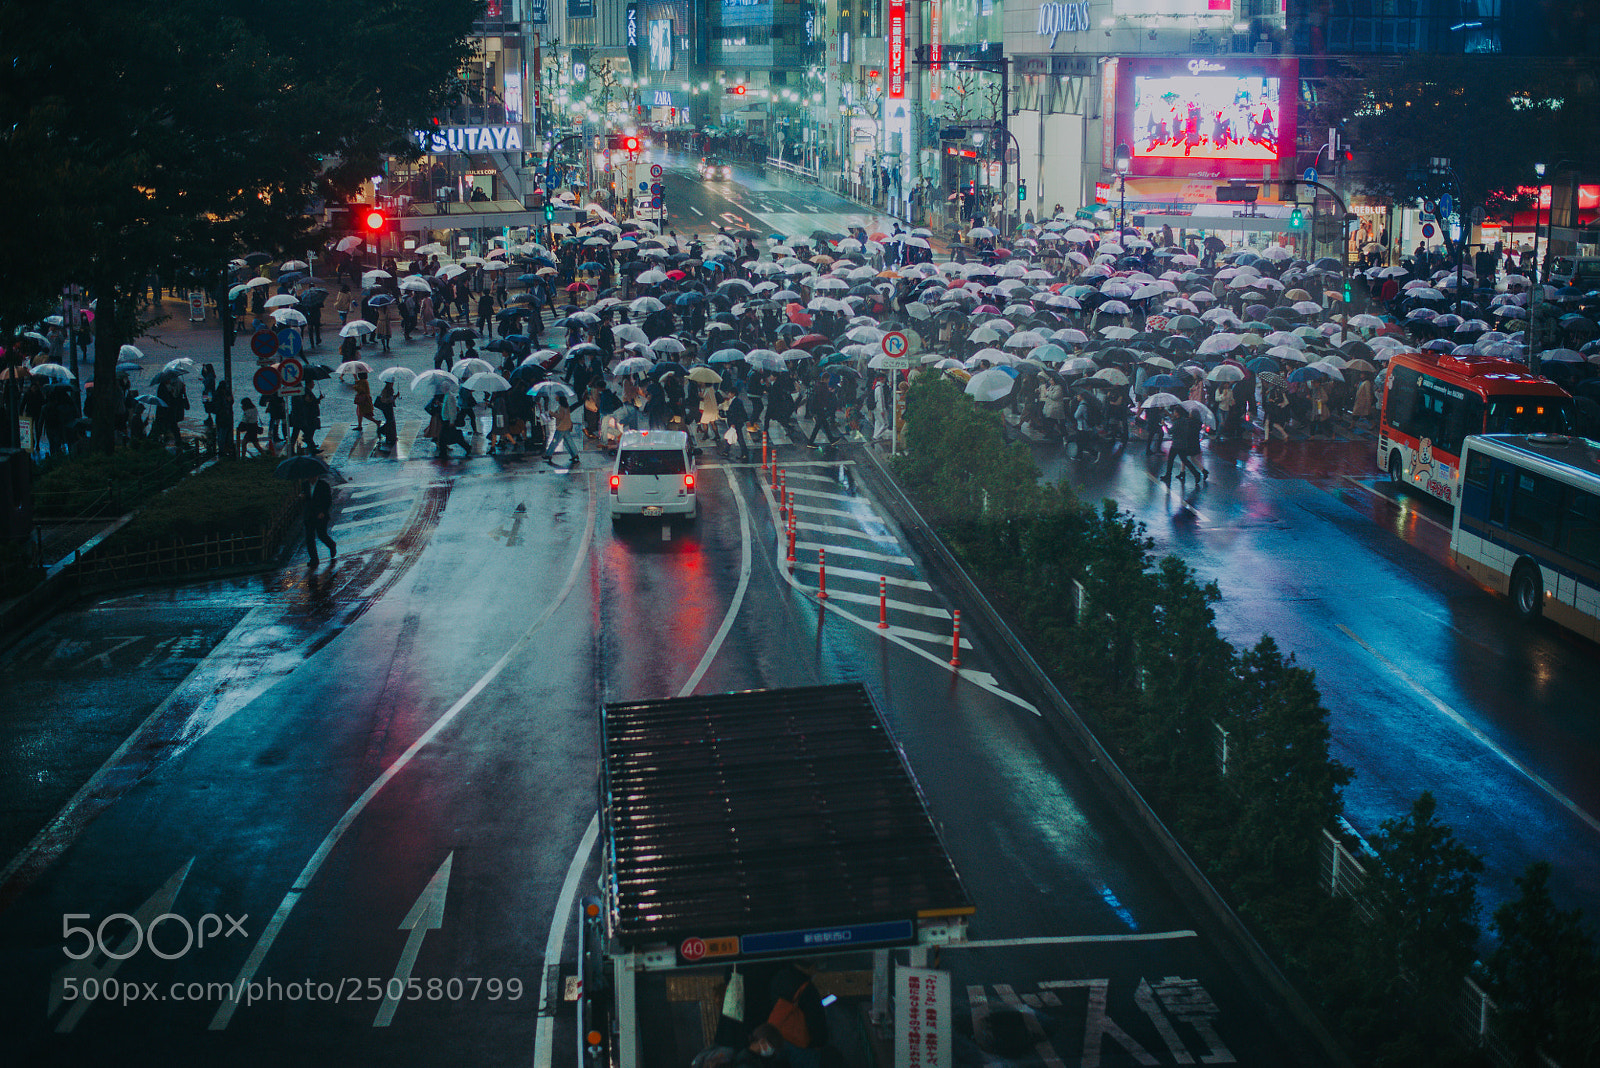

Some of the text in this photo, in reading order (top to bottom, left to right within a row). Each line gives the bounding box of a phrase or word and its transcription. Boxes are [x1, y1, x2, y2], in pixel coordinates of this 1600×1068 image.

[628, 9, 637, 46] ZARA
[892, 17, 902, 93] 三菱東京UFJ銀行
[1187, 58, 1226, 76] Glico
[654, 91, 672, 105] ZARA
[413, 126, 522, 152] TSUTAYA
[684, 941, 703, 956] 40
